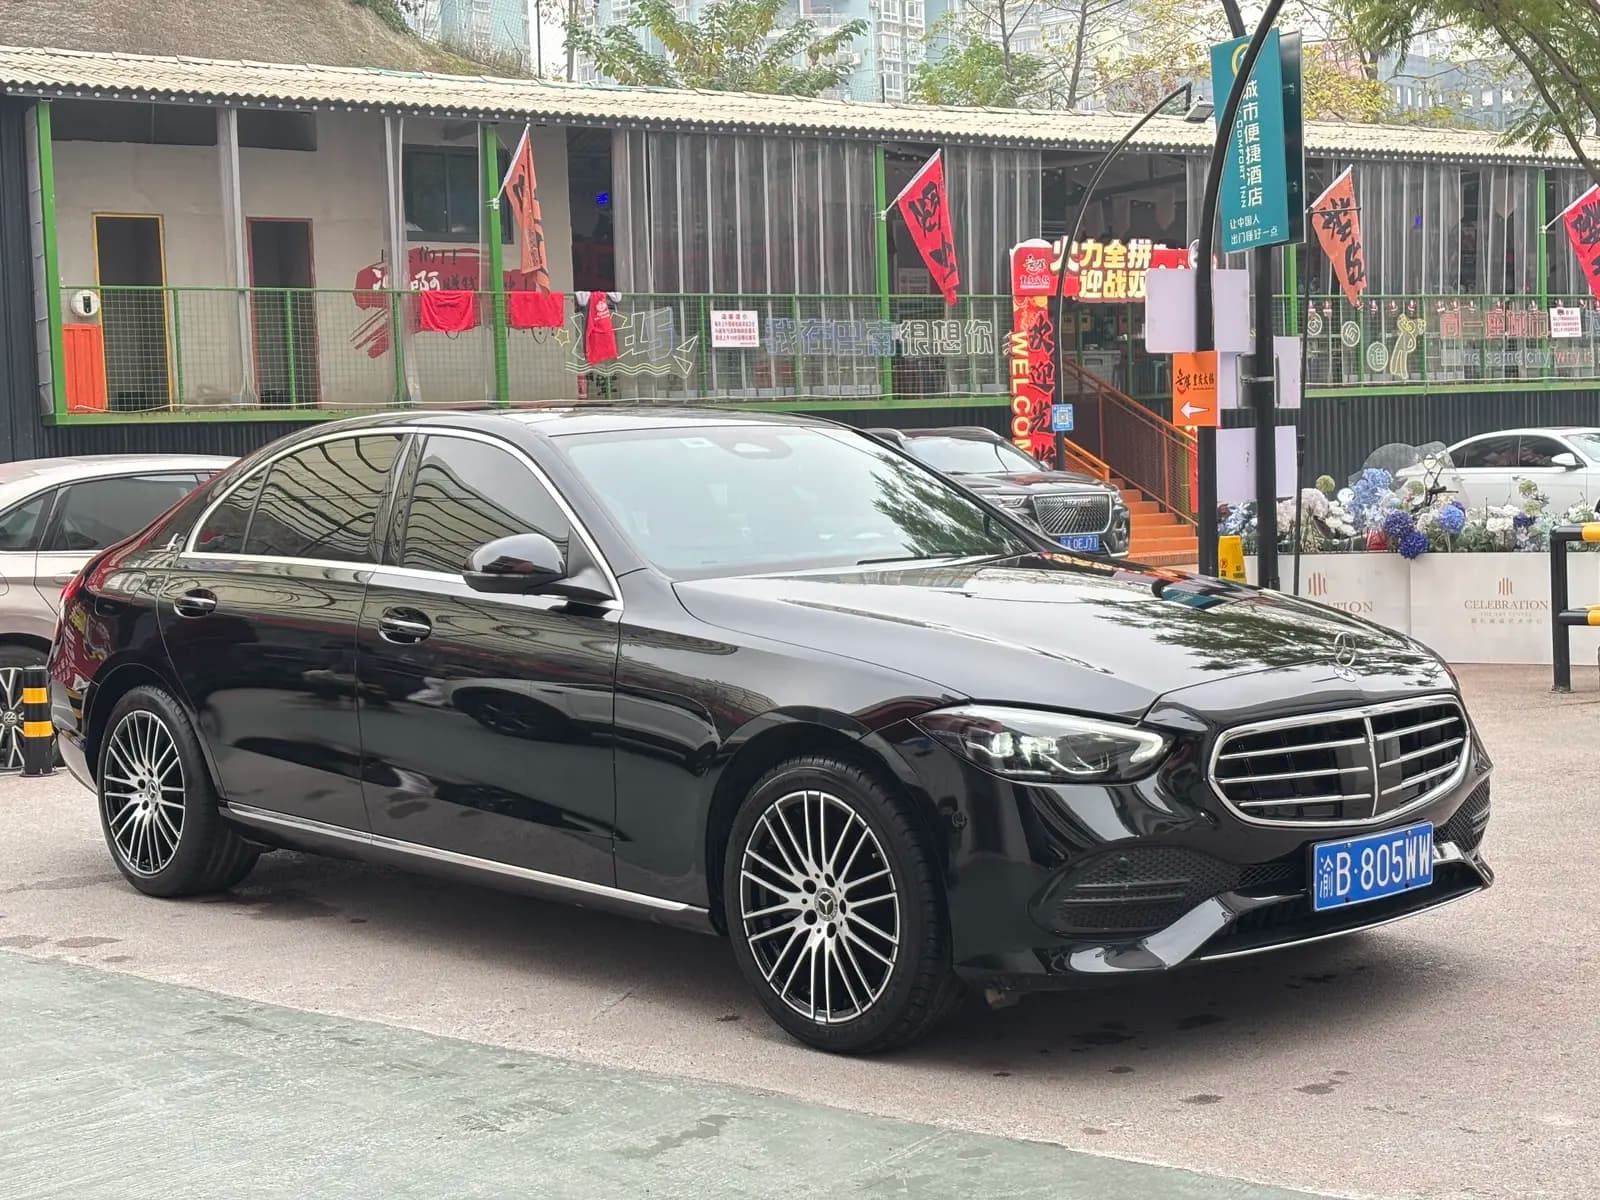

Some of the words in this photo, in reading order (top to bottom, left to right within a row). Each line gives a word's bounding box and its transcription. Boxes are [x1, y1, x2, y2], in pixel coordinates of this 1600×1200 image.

[1236, 120, 1246, 180] COMFORT
[1242, 79, 1263, 208] 城市便捷酒店
[1239, 185, 1247, 208] INN
[1229, 213, 1260, 230] 让中国人
[1230, 225, 1279, 245] 出门睡好一点
[1051, 236, 1151, 272] 火力全拼
[765, 317, 994, 356] 我在巴南很想你
[1464, 599, 1549, 610] CELEBRATION
[1319, 832, 1431, 898] 渝B·805WW
